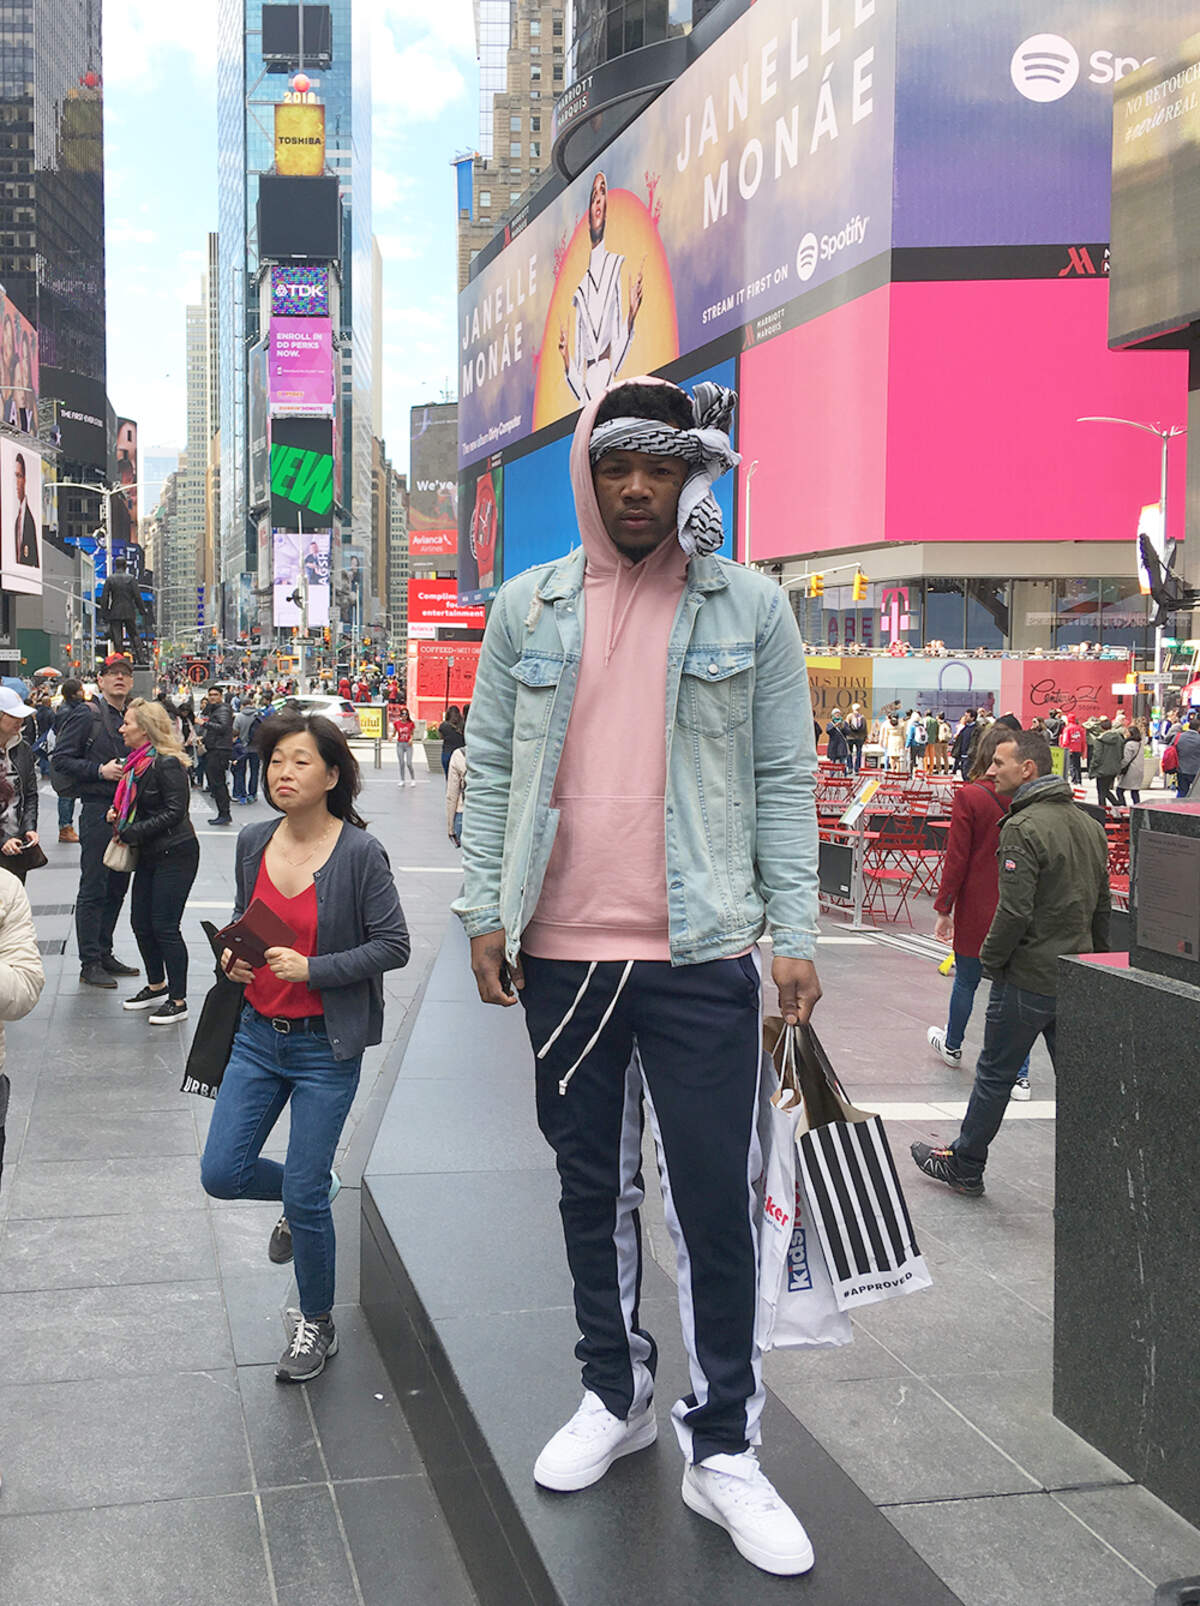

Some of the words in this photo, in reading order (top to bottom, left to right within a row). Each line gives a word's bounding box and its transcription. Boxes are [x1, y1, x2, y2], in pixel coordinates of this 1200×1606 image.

[278, 136, 322, 145] TOSHIBA
[704, 46, 874, 230] MONÁE
[820, 214, 868, 261] Spotify
[286, 284, 324, 297] TDK
[462, 254, 537, 351] JANELLE
[702, 293, 734, 325] STREAM
[736, 288, 745, 305] IT
[747, 273, 772, 300] FIRST
[774, 263, 789, 285] ON
[276, 332, 311, 340] ENROLL
[276, 341, 290, 349] DD
[291, 341, 319, 349] PERKS
[462, 321, 522, 398] MONÁE
[416, 480, 454, 491] We've
[421, 609, 484, 617] entertainment
[183, 1075, 218, 1099] URBA
[763, 1195, 789, 1227] ker
[788, 1229, 811, 1291] kids
[843, 1271, 913, 1298] #APPROVED
